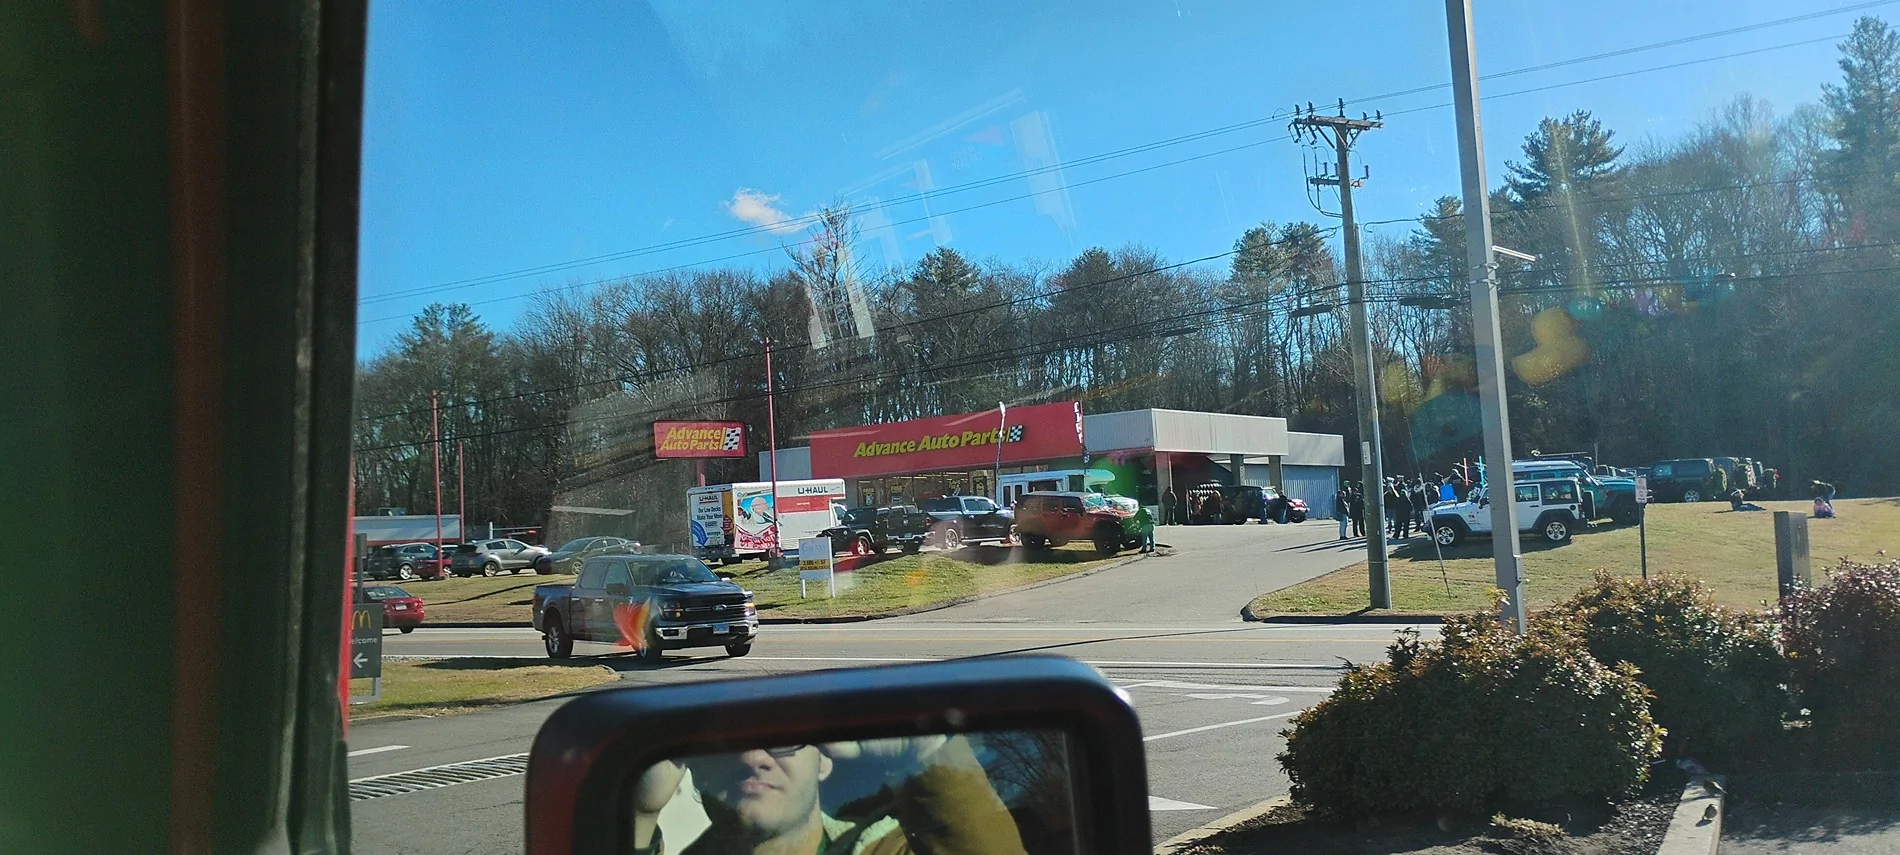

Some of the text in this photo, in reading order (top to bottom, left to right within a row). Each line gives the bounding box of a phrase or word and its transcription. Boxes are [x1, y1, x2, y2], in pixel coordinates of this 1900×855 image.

[667, 427, 720, 440] Advance
[660, 439, 719, 450] Auto Parts
[854, 430, 1006, 458] Advance Auto Parts
[797, 486, 828, 494] U-HAUL
[351, 637, 377, 645] elcome
